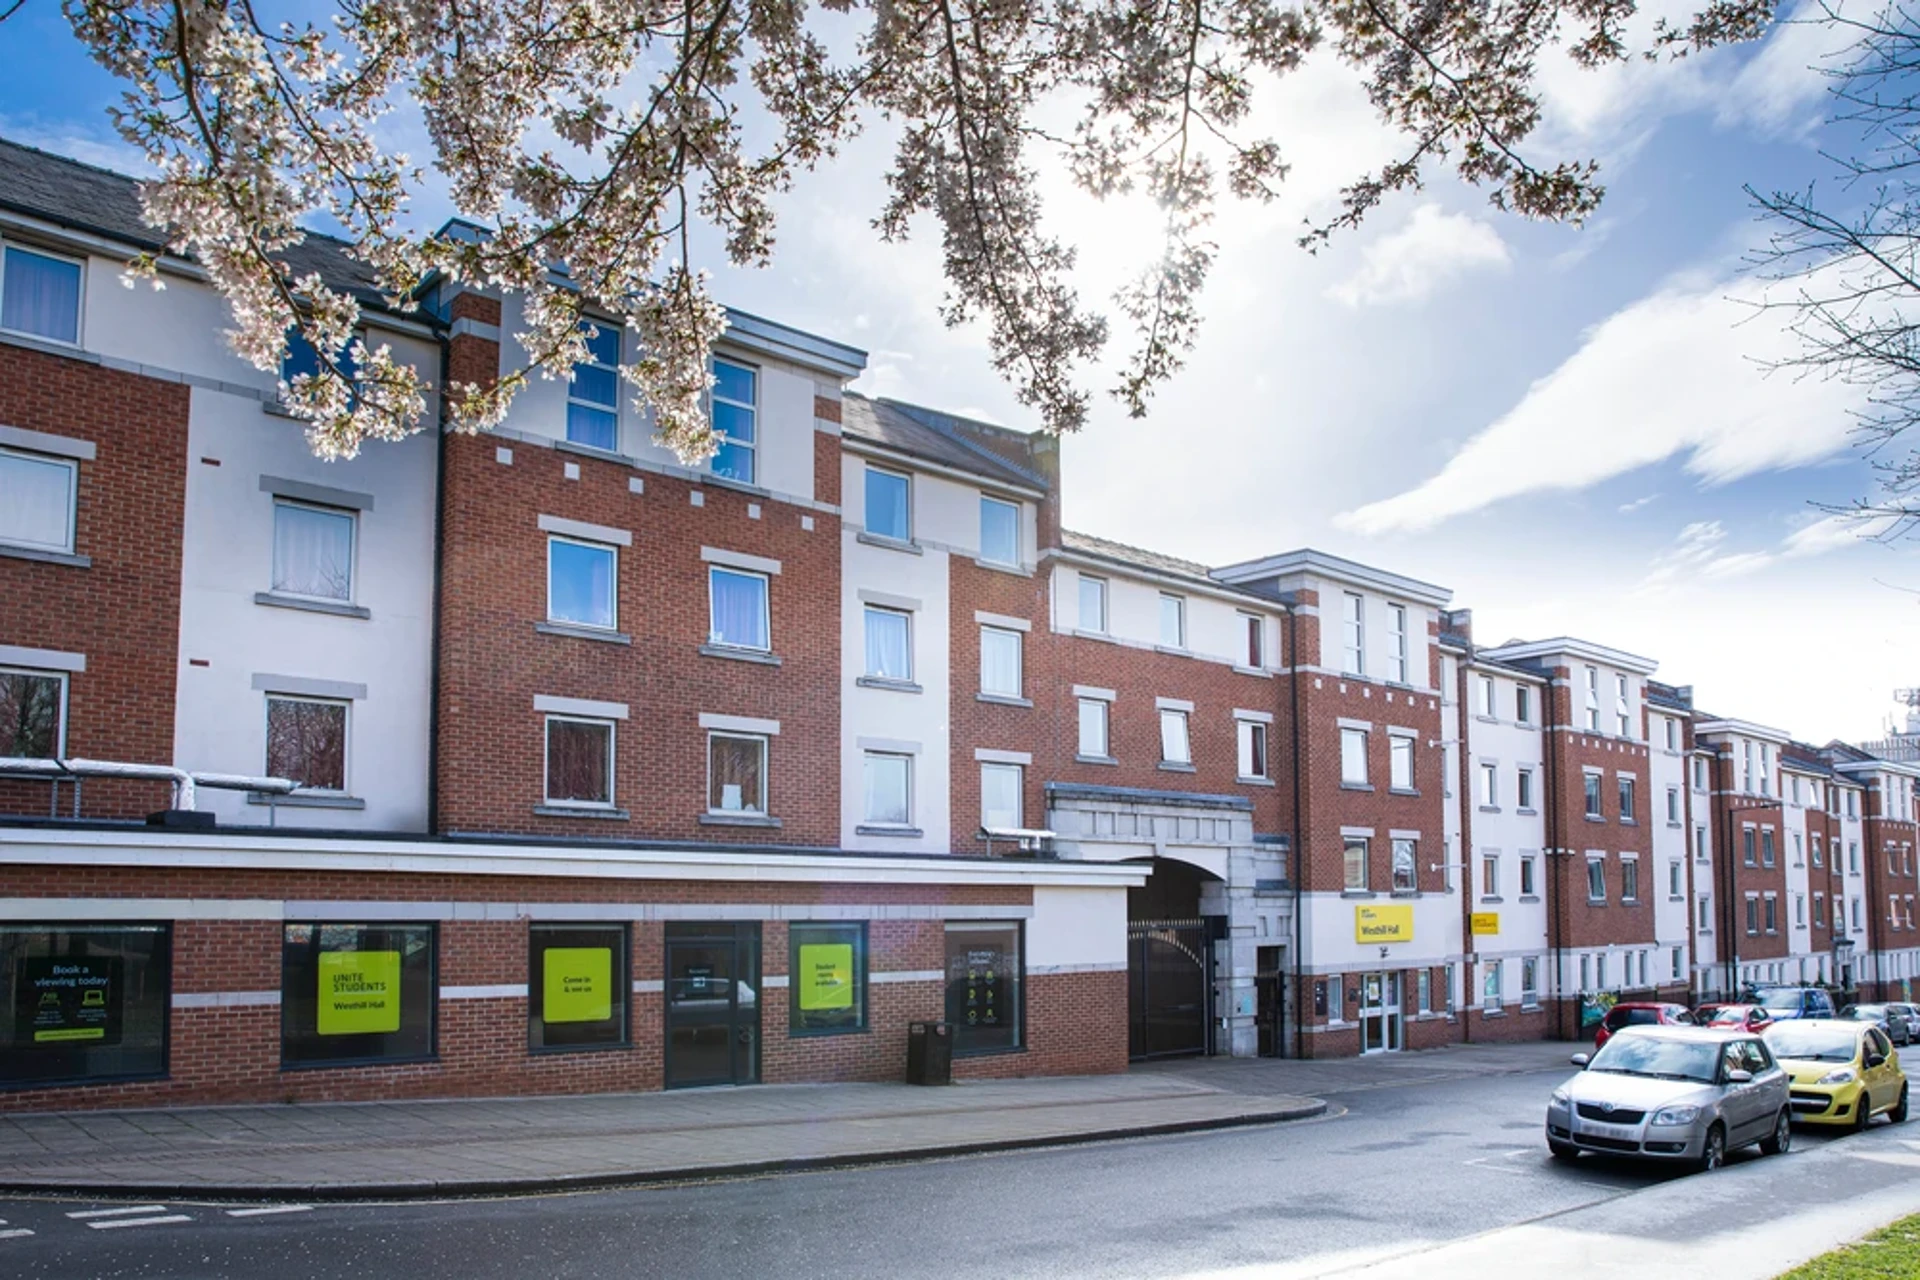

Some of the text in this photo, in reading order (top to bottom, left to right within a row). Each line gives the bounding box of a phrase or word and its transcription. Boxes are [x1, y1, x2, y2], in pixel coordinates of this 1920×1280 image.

[1361, 925, 1399, 935] Westhill Hall
[53, 965, 80, 974] Book
[34, 977, 108, 987] viewing today
[333, 973, 364, 982] UNITE
[333, 982, 387, 992] STUDENTS
[334, 1001, 367, 1010] Westhill
